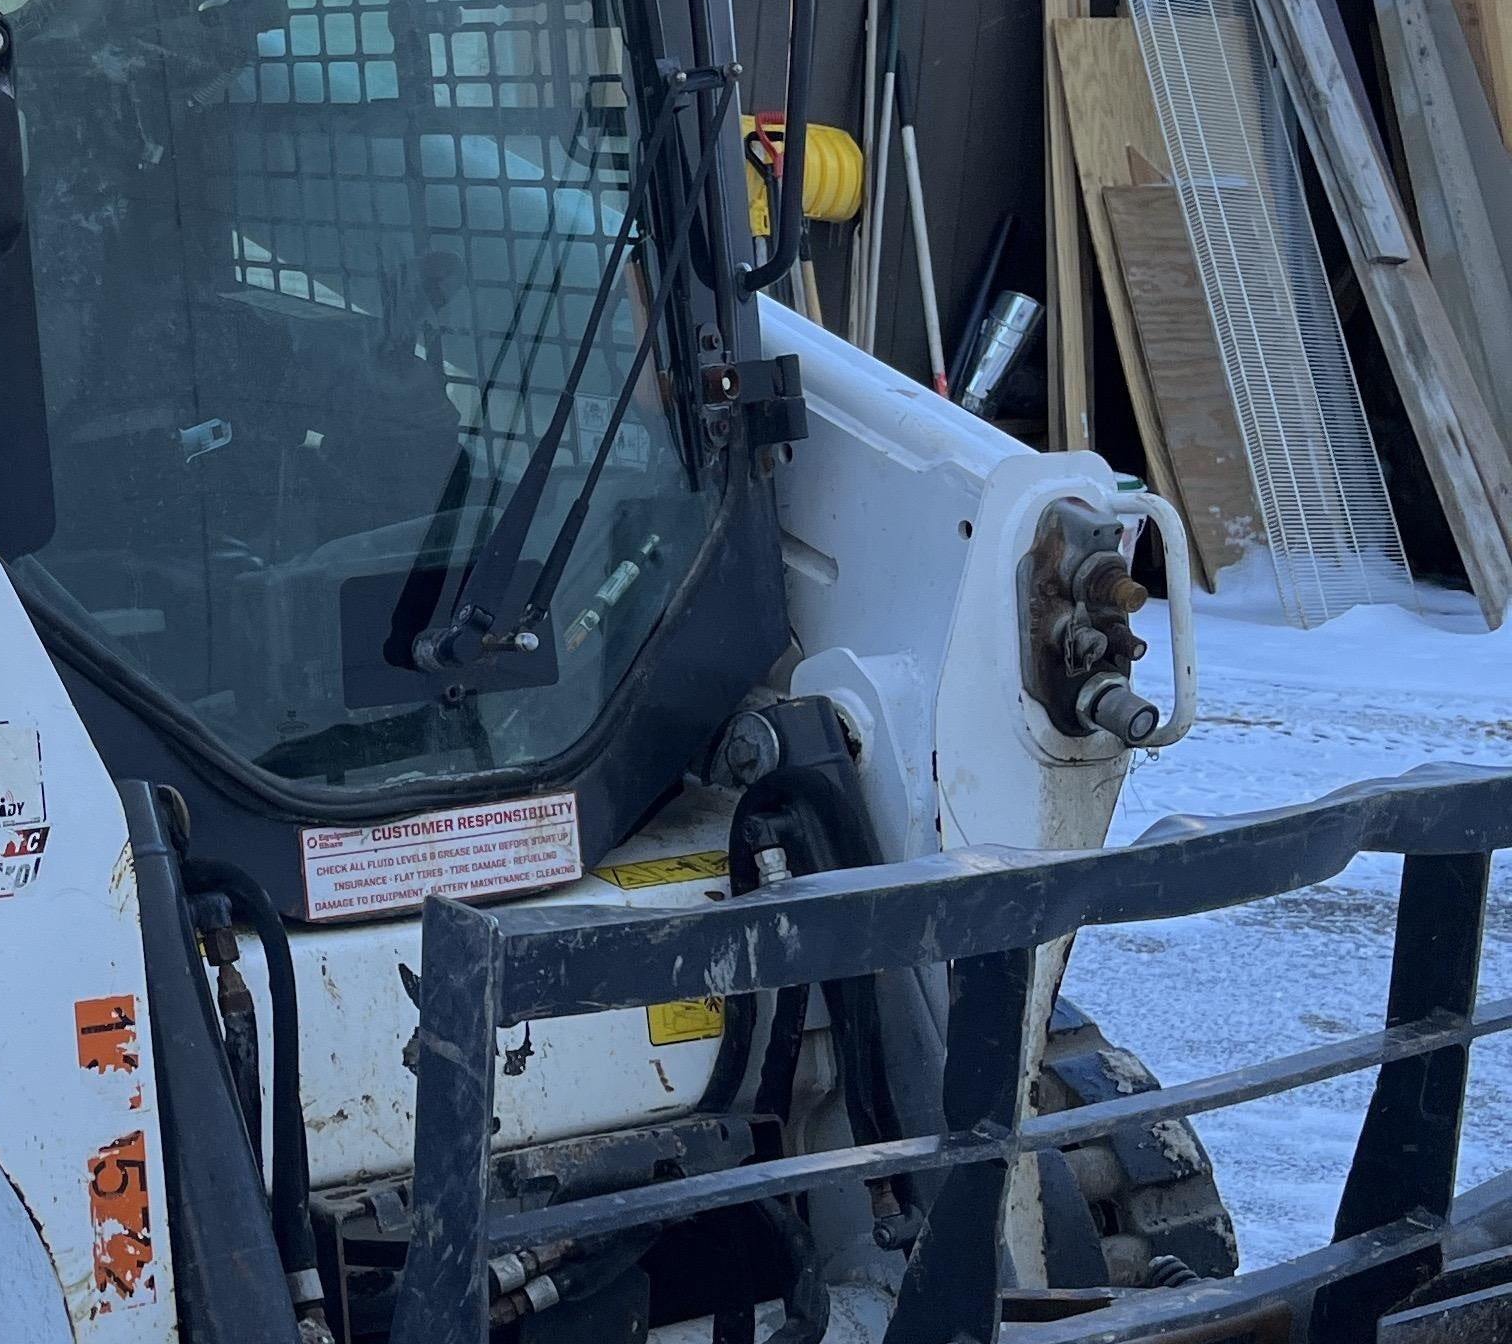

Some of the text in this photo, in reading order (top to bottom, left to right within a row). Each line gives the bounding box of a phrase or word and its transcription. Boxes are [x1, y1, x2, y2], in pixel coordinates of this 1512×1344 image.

[371, 818, 454, 842] CUSTOMER
[457, 801, 573, 830] RESPONSIBILITY
[316, 864, 350, 877] CHECK
[349, 861, 366, 872] ALL
[367, 857, 395, 870] FLUID
[396, 852, 428, 866] LEVELS
[437, 846, 470, 859] GREASE
[472, 842, 497, 855] DAILY
[498, 838, 529, 851] BEFORE
[531, 834, 557, 846] START
[556, 831, 569, 842] UP
[334, 850, 558, 892] INSURANCE FLAT TIRES TIRE DAMAGE REFUELING
[314, 864, 576, 912] DAMAGE TO EQUIPMENT BATTERY MAINTENANCE CLEANING
